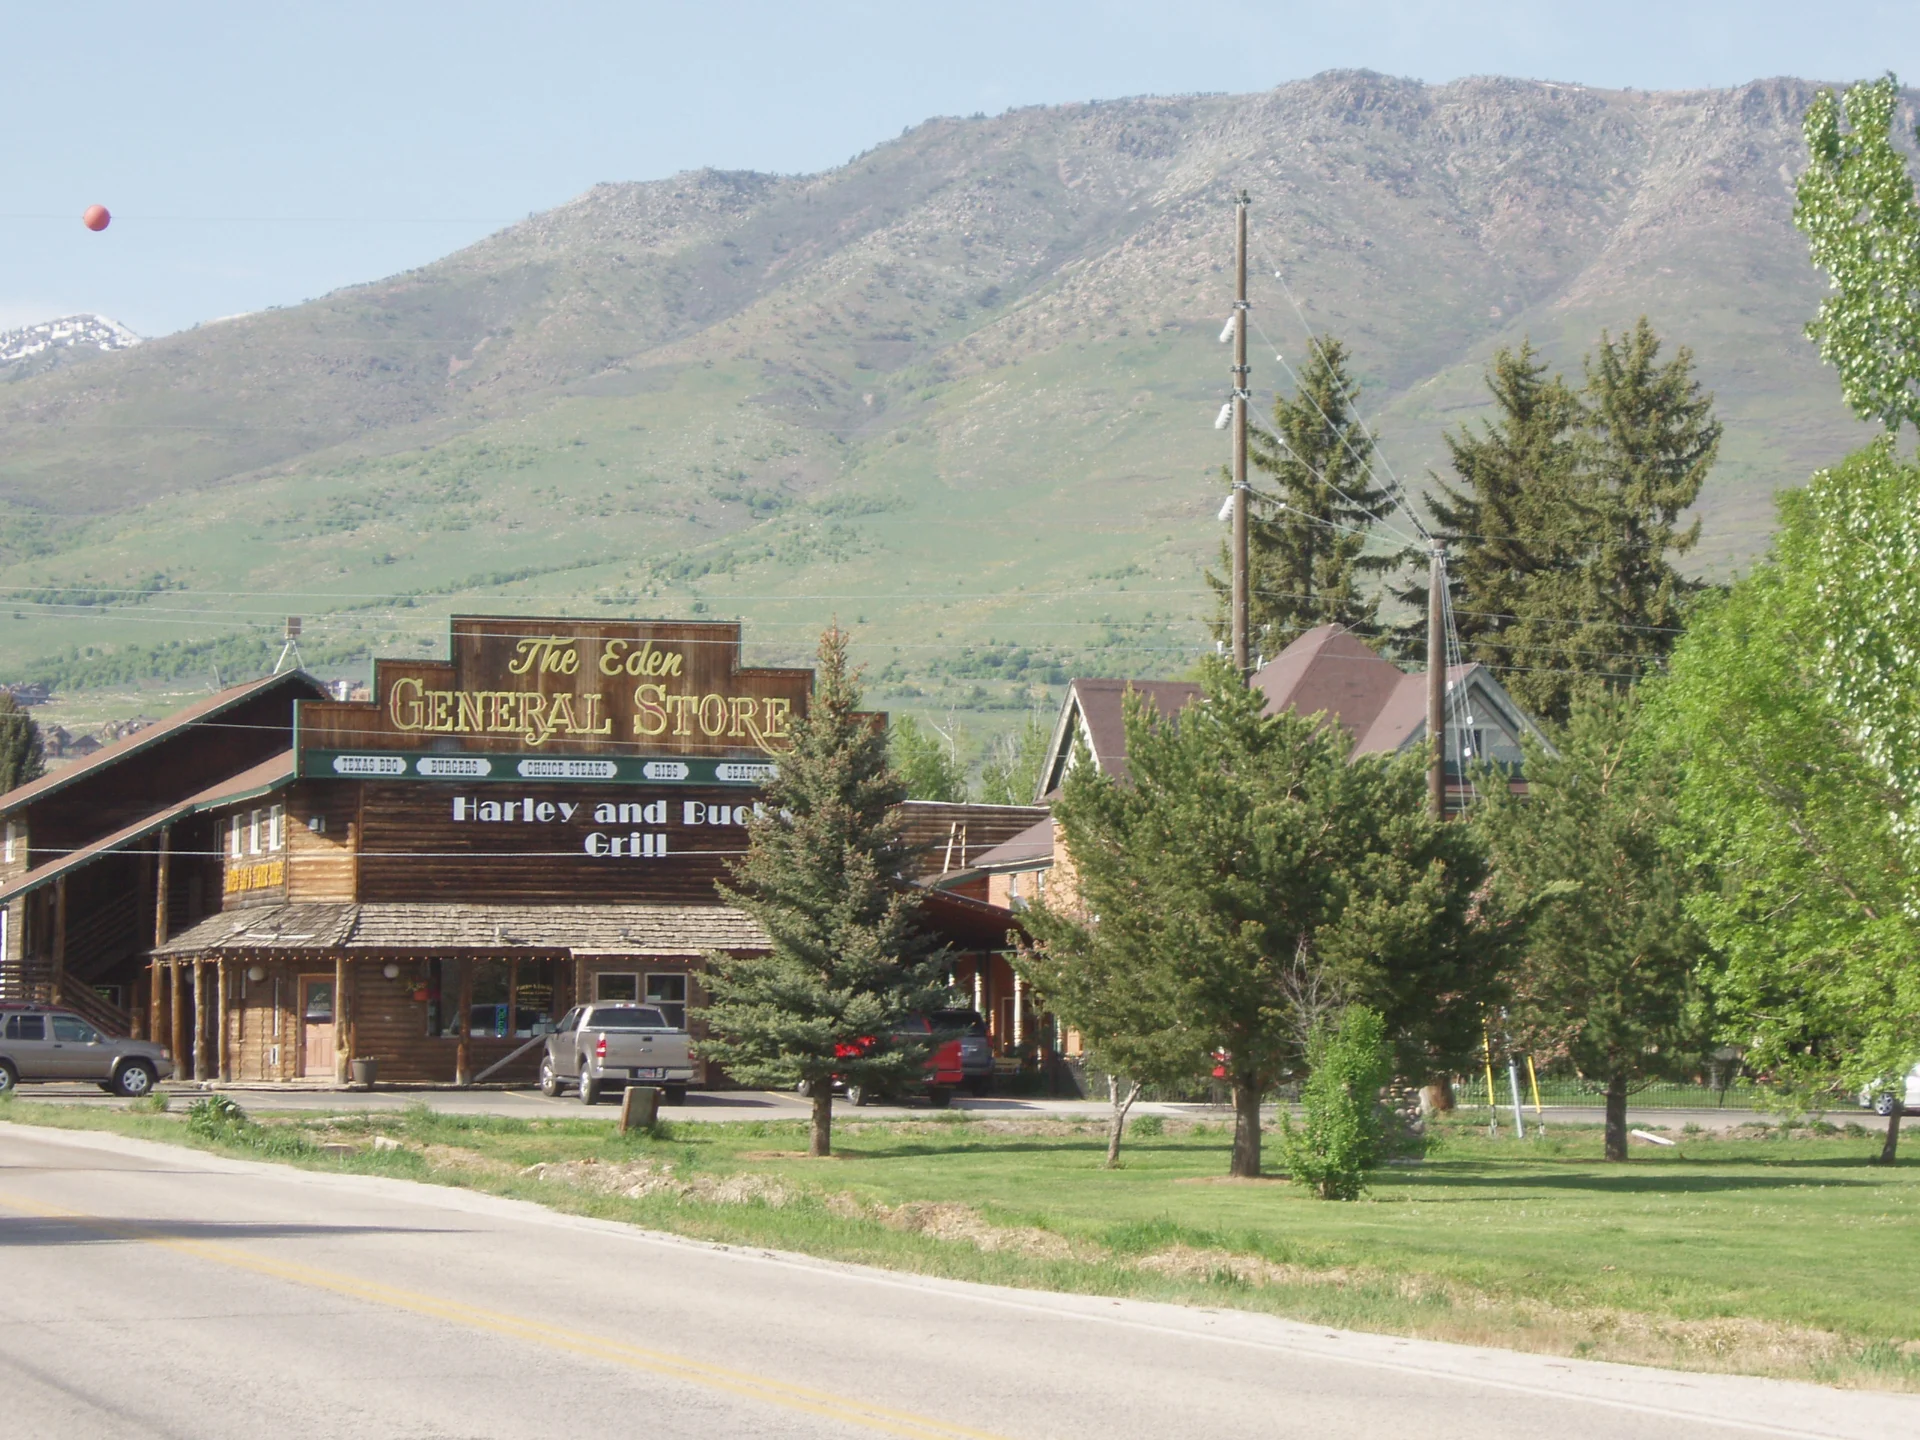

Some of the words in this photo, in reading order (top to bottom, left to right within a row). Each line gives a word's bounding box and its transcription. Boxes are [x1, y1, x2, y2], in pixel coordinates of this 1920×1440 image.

[508, 634, 580, 675] The
[600, 638, 683, 677] Eden
[389, 677, 611, 746] GENERAL
[633, 683, 797, 755] STORE
[342, 757, 375, 772] TEXAS
[379, 758, 398, 773] BBQ
[431, 759, 478, 774] BURGERS
[527, 761, 564, 776] CHOICE
[569, 762, 608, 777] STEAKS
[654, 763, 679, 778] RIBS
[453, 796, 579, 823] Harley
[594, 799, 667, 824] and
[584, 831, 667, 858] Grill
